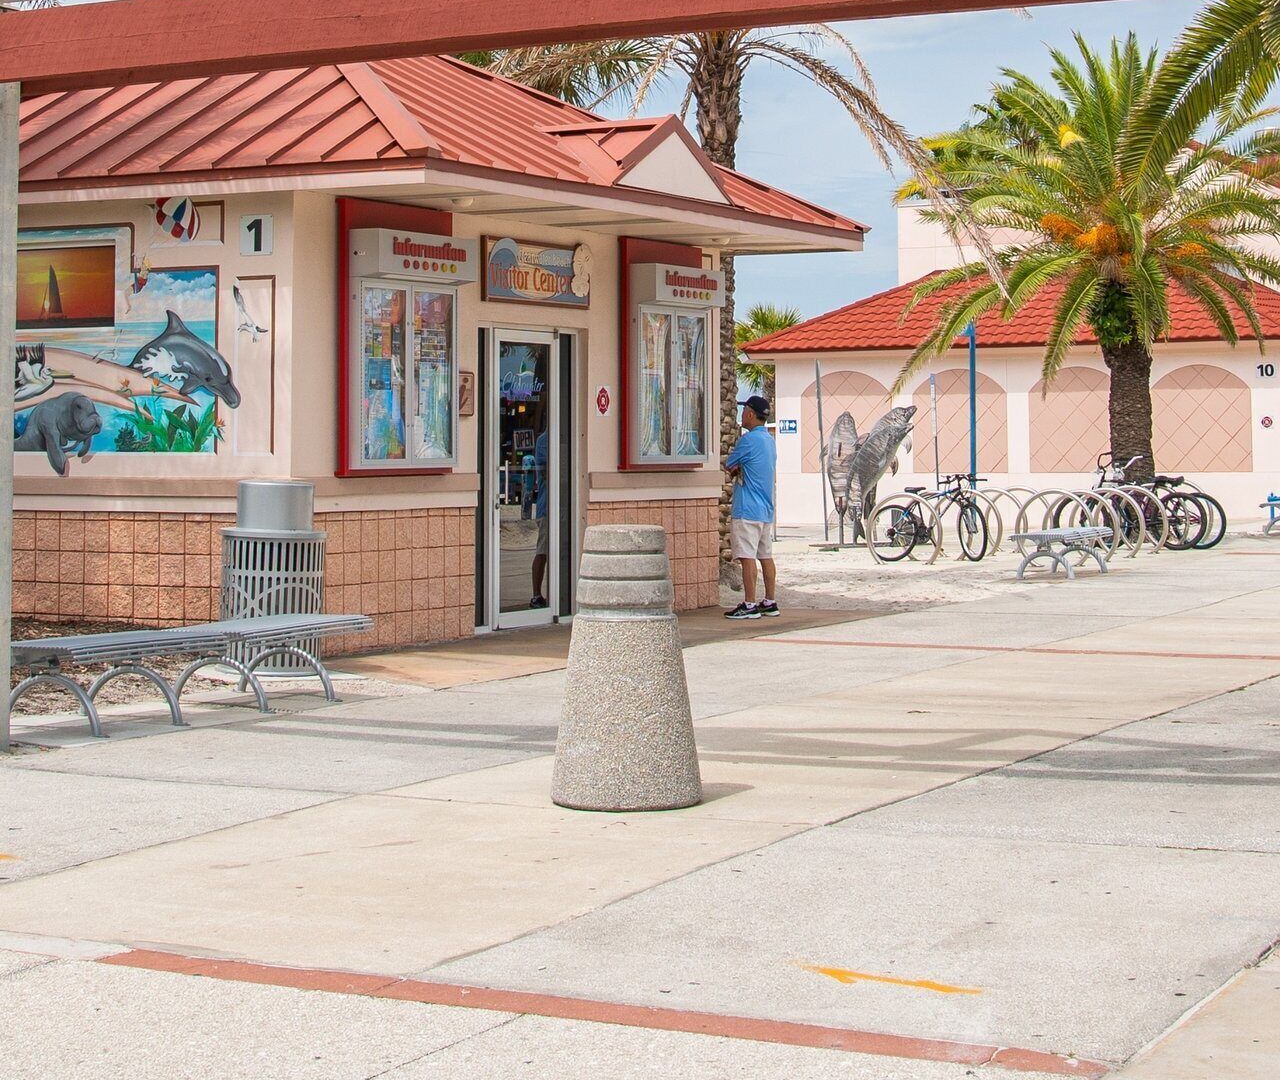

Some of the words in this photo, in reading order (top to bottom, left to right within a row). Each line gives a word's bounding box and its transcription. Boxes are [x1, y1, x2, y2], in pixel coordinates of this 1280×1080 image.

[246, 218, 262, 252] 1
[392, 235, 467, 262] information
[489, 262, 530, 291] Visitor
[532, 267, 574, 296] Center
[665, 269, 718, 291] information
[1257, 363, 1274, 377] 10
[515, 430, 534, 448] OPEN
